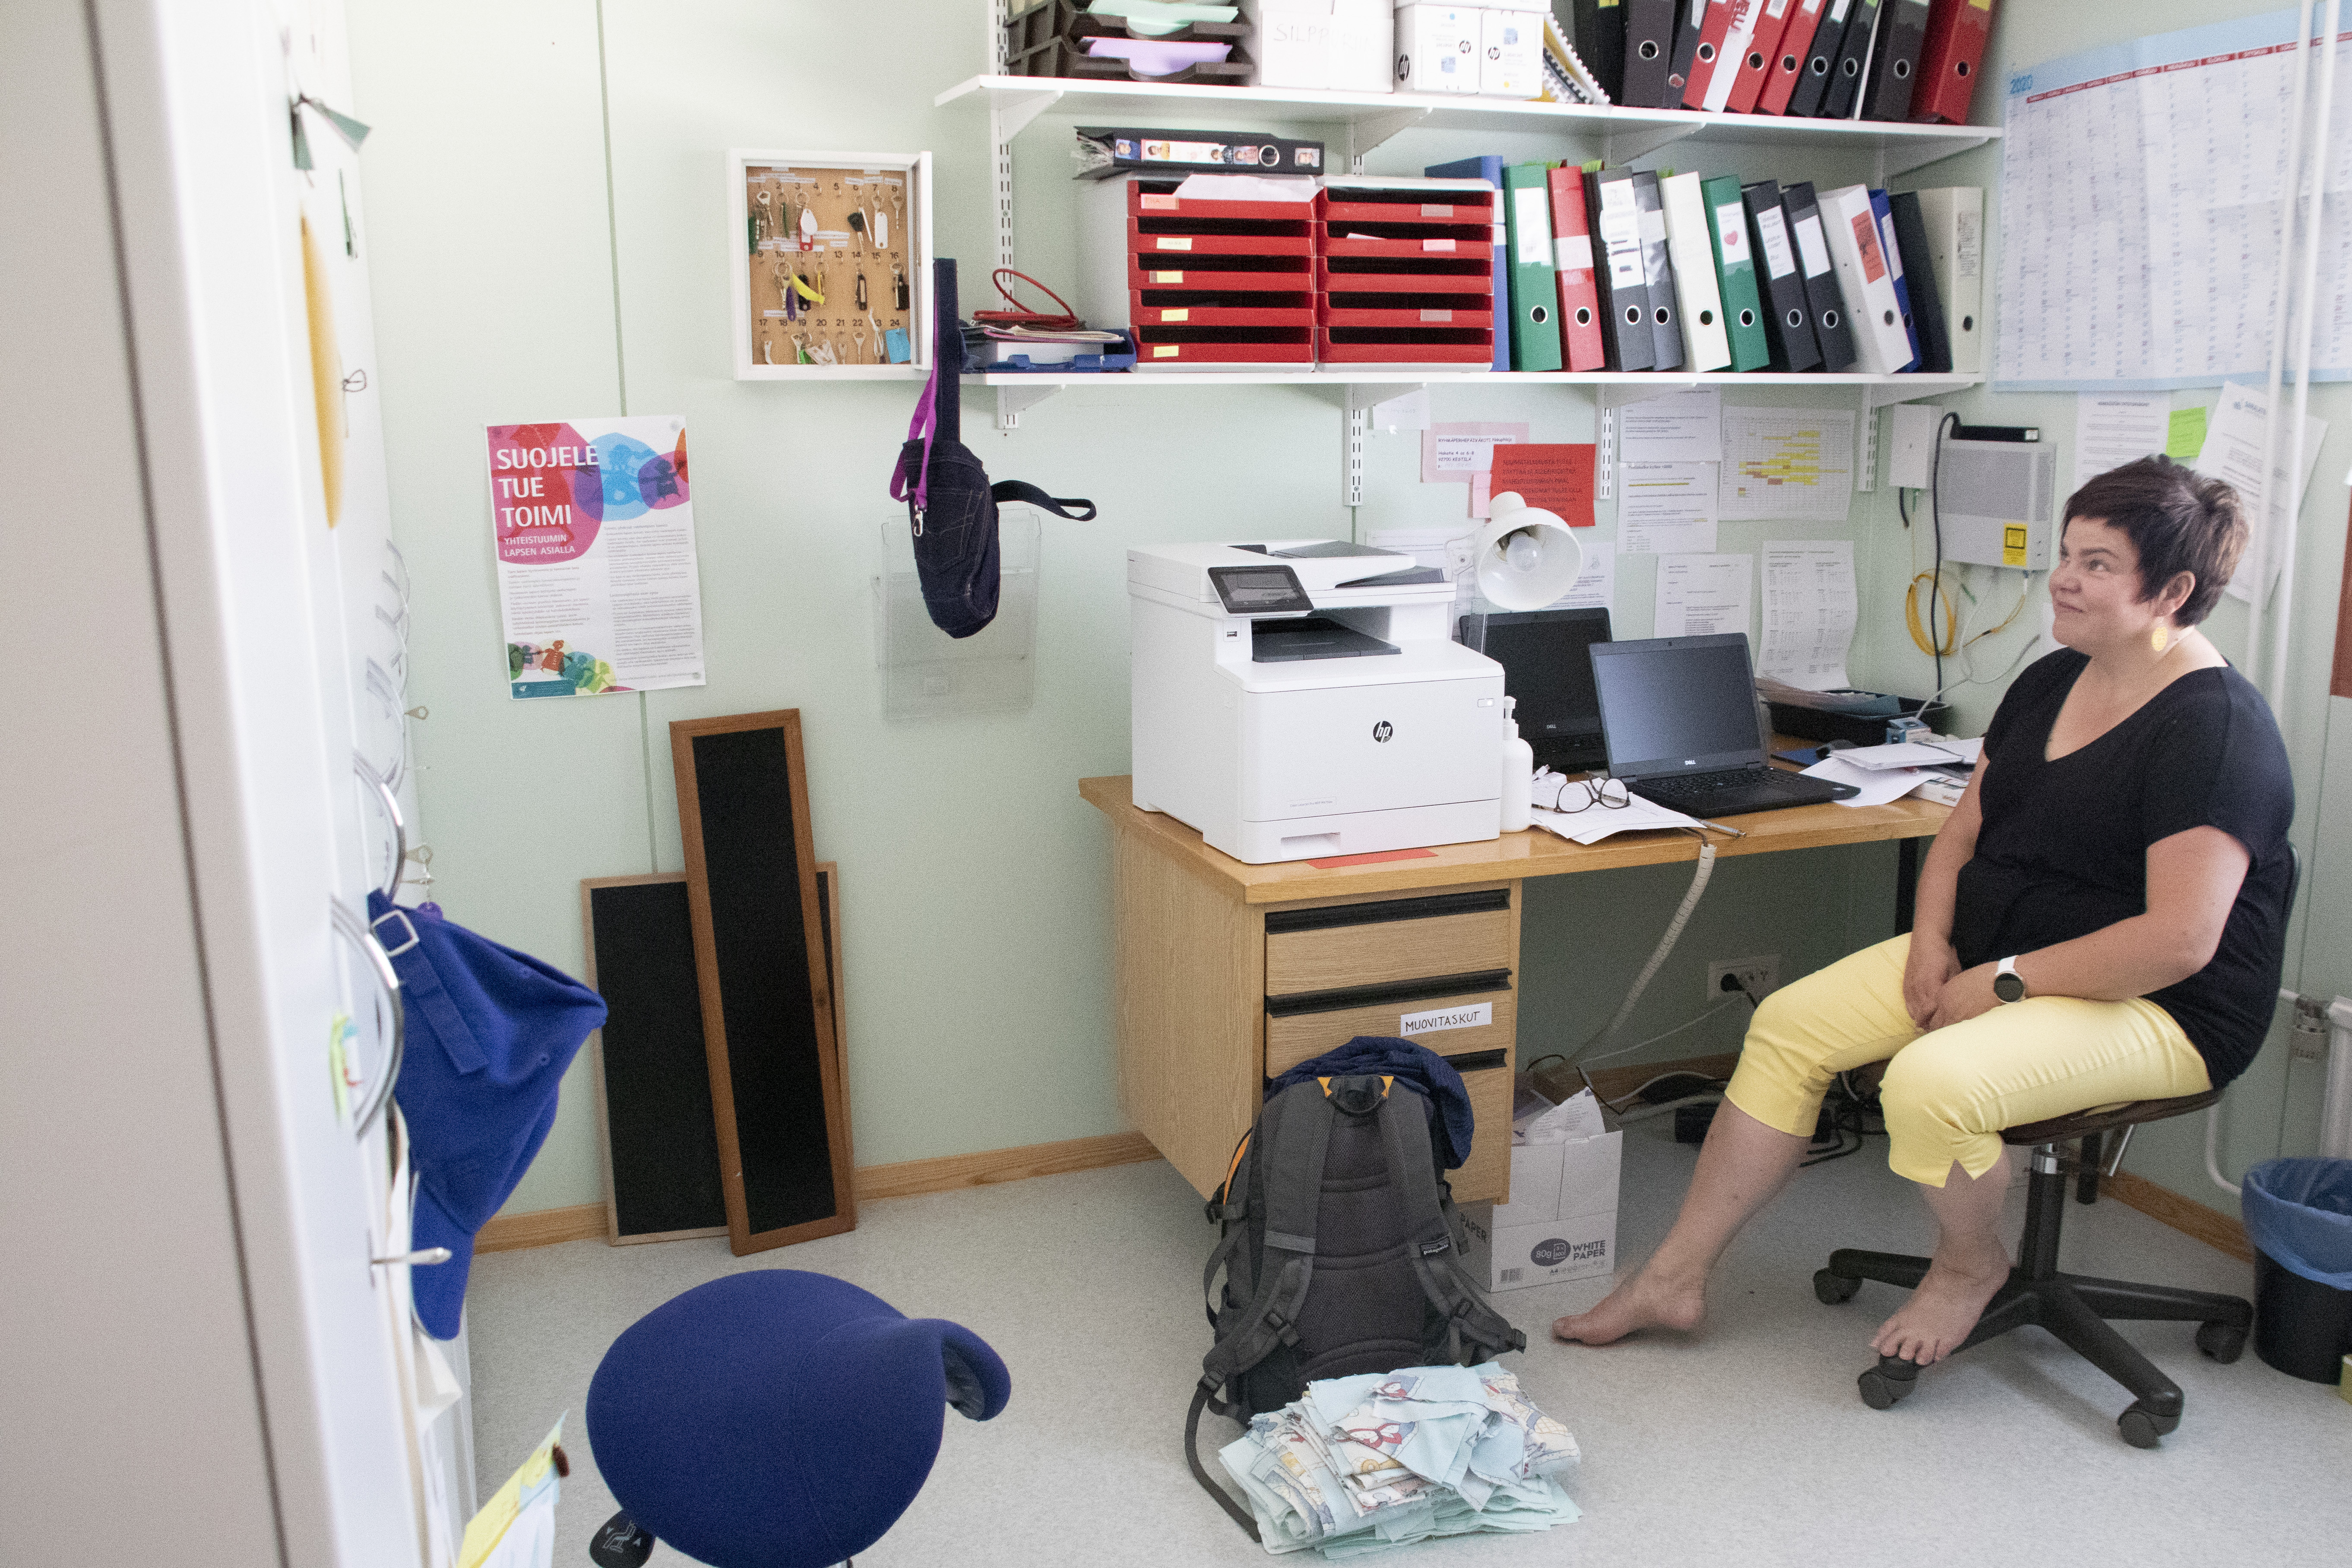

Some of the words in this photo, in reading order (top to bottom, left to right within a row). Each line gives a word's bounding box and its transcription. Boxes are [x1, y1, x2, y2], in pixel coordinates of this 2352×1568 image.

[1459, 40, 1472, 54] hp
[1488, 47, 1500, 60] hp
[2010, 74, 2033, 94] 2020
[497, 445, 599, 469] SUOJELE
[498, 477, 544, 498] TUE
[501, 504, 572, 527] TOIMI
[504, 534, 567, 545] YHTEISTUUMIN
[504, 548, 537, 557] LAPSEN
[540, 545, 576, 555] ASIALLA
[1373, 720, 1393, 743] hp
[1406, 1011, 1480, 1032] MUOVITASKUT
[1424, 1244, 1448, 1255] patagonia
[1573, 1240, 1605, 1252] WHITE
[1536, 1250, 1552, 1258] 80g
[1573, 1248, 1605, 1261] PAPER
